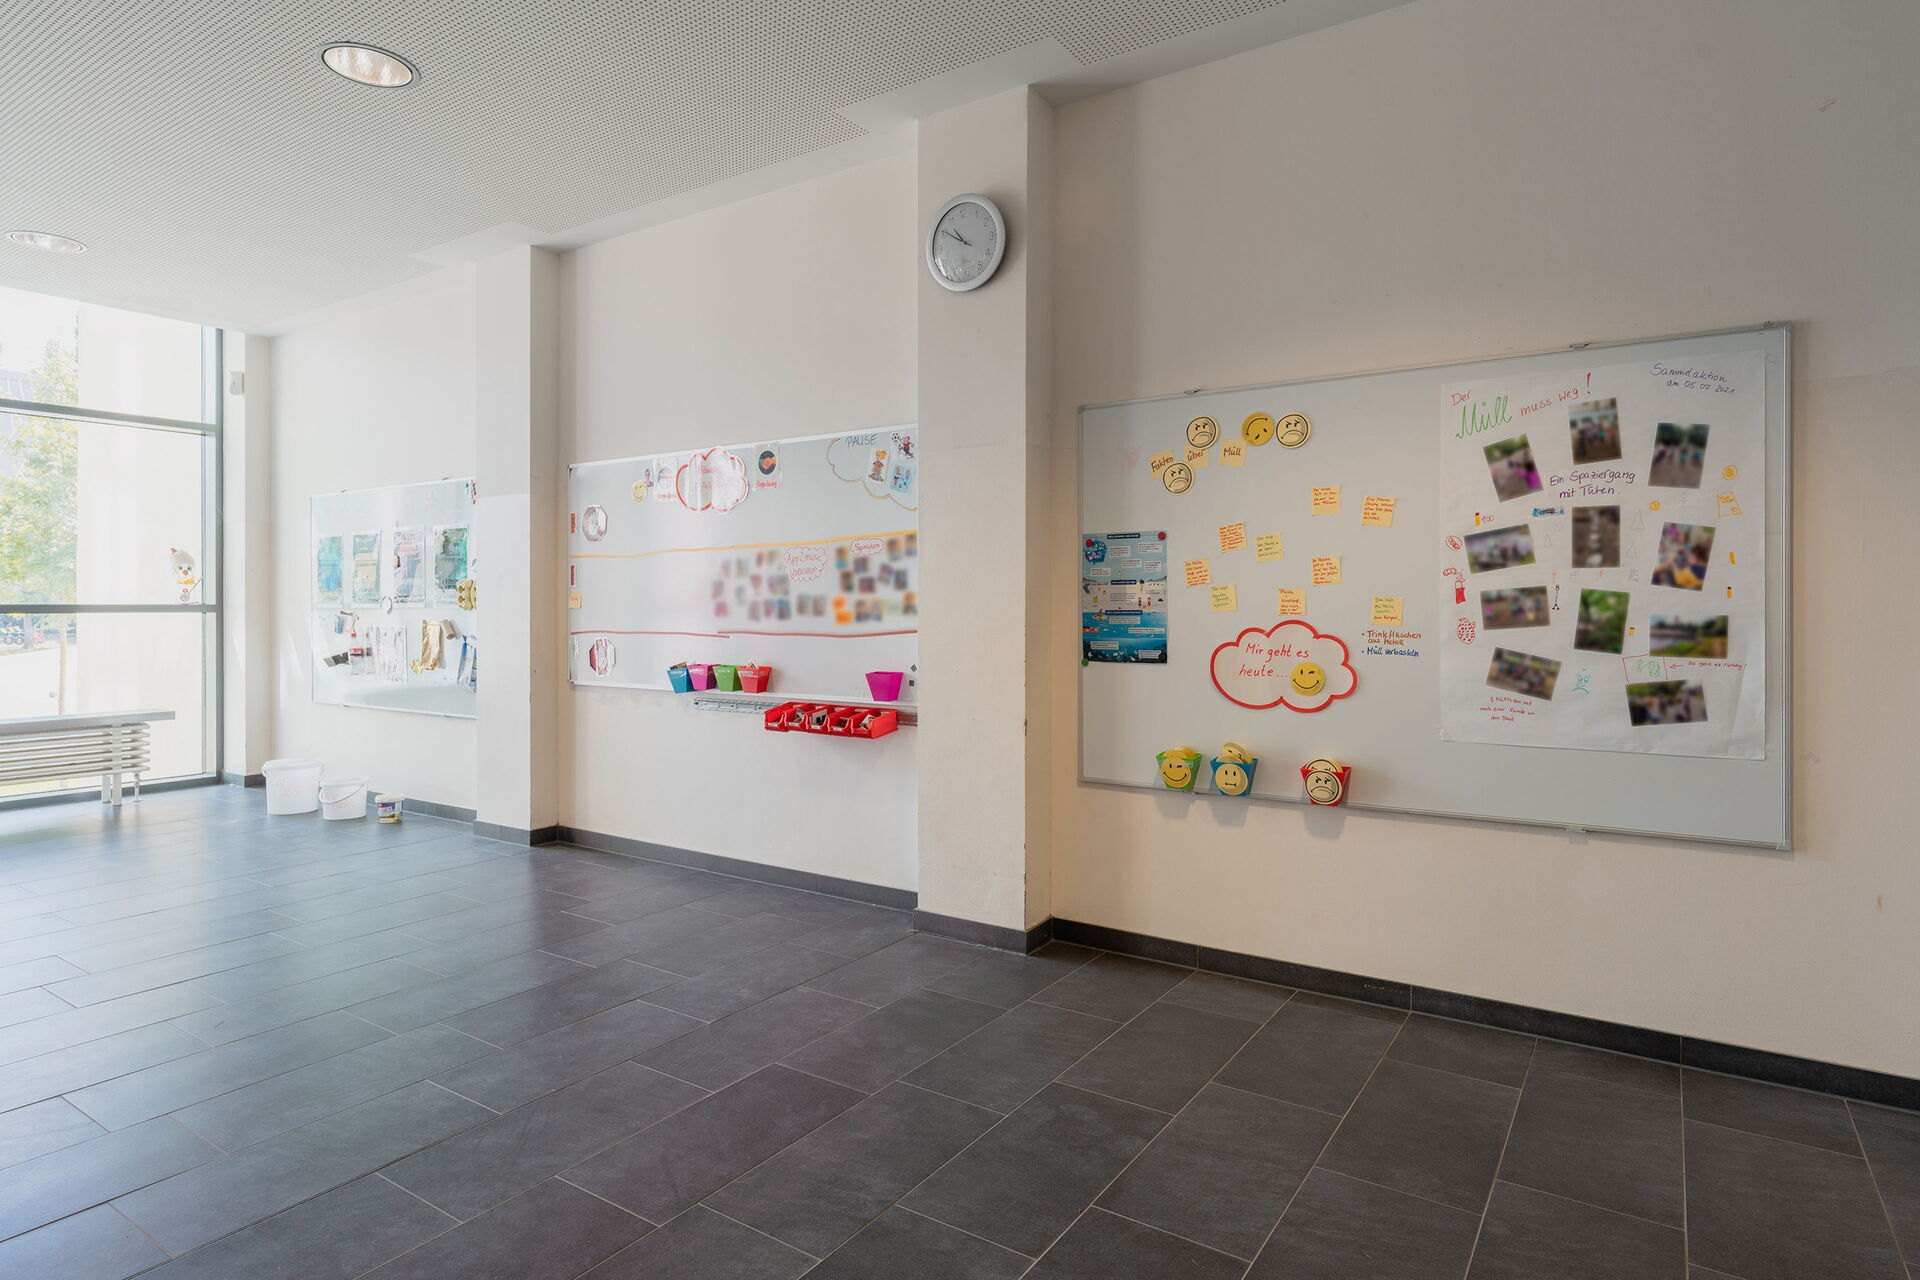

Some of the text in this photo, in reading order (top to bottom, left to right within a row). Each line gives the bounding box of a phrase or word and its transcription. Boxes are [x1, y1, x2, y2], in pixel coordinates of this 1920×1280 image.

[1451, 389, 1472, 406] Der
[1715, 385, 1735, 395] 2021
[1456, 395, 1512, 439] Müll
[1520, 399, 1552, 416] muss
[845, 434, 877, 447] PAUSE
[1151, 446, 1241, 472] Fakten über Müll
[1550, 469, 1635, 486] Ein Spaziergang
[1560, 488, 1576, 498] mit
[1246, 643, 1309, 663] Mir geht es
[1366, 645, 1382, 655] Müll
